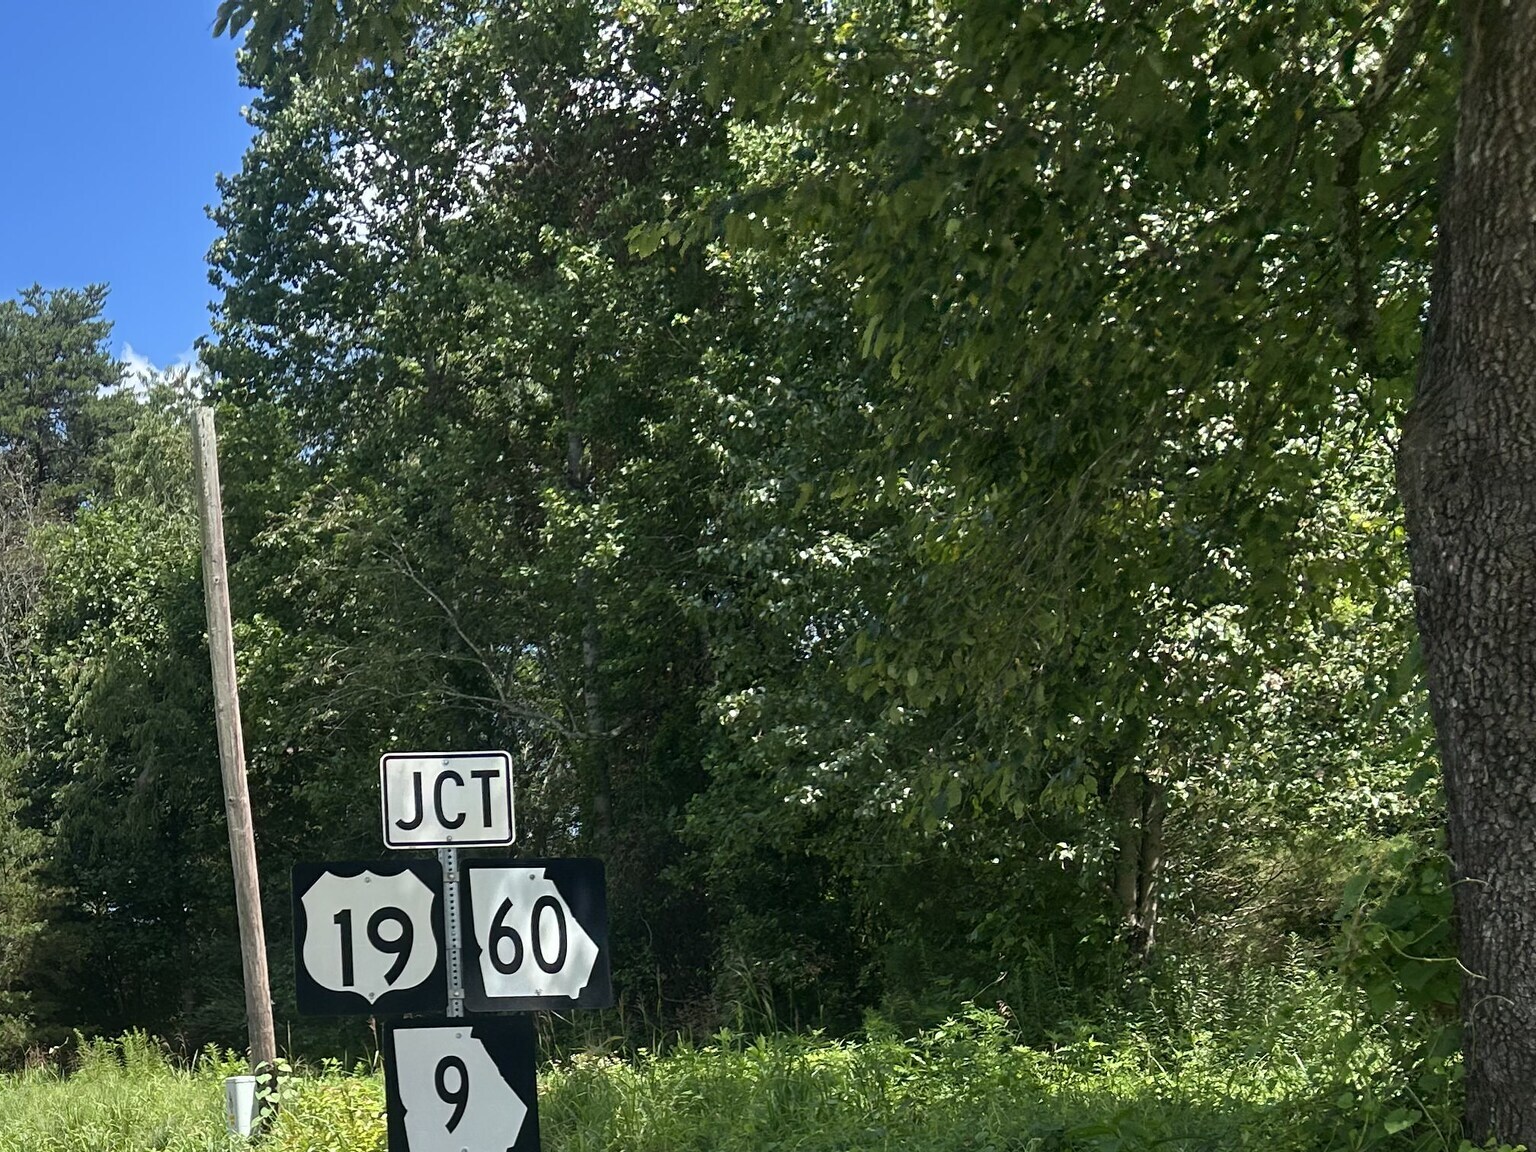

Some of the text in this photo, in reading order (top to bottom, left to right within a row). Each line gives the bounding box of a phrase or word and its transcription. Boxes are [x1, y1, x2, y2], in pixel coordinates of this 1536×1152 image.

[395, 769, 500, 831] JCT
[333, 906, 414, 987] 19
[488, 895, 568, 975] 60
[434, 1055, 470, 1134] 9
